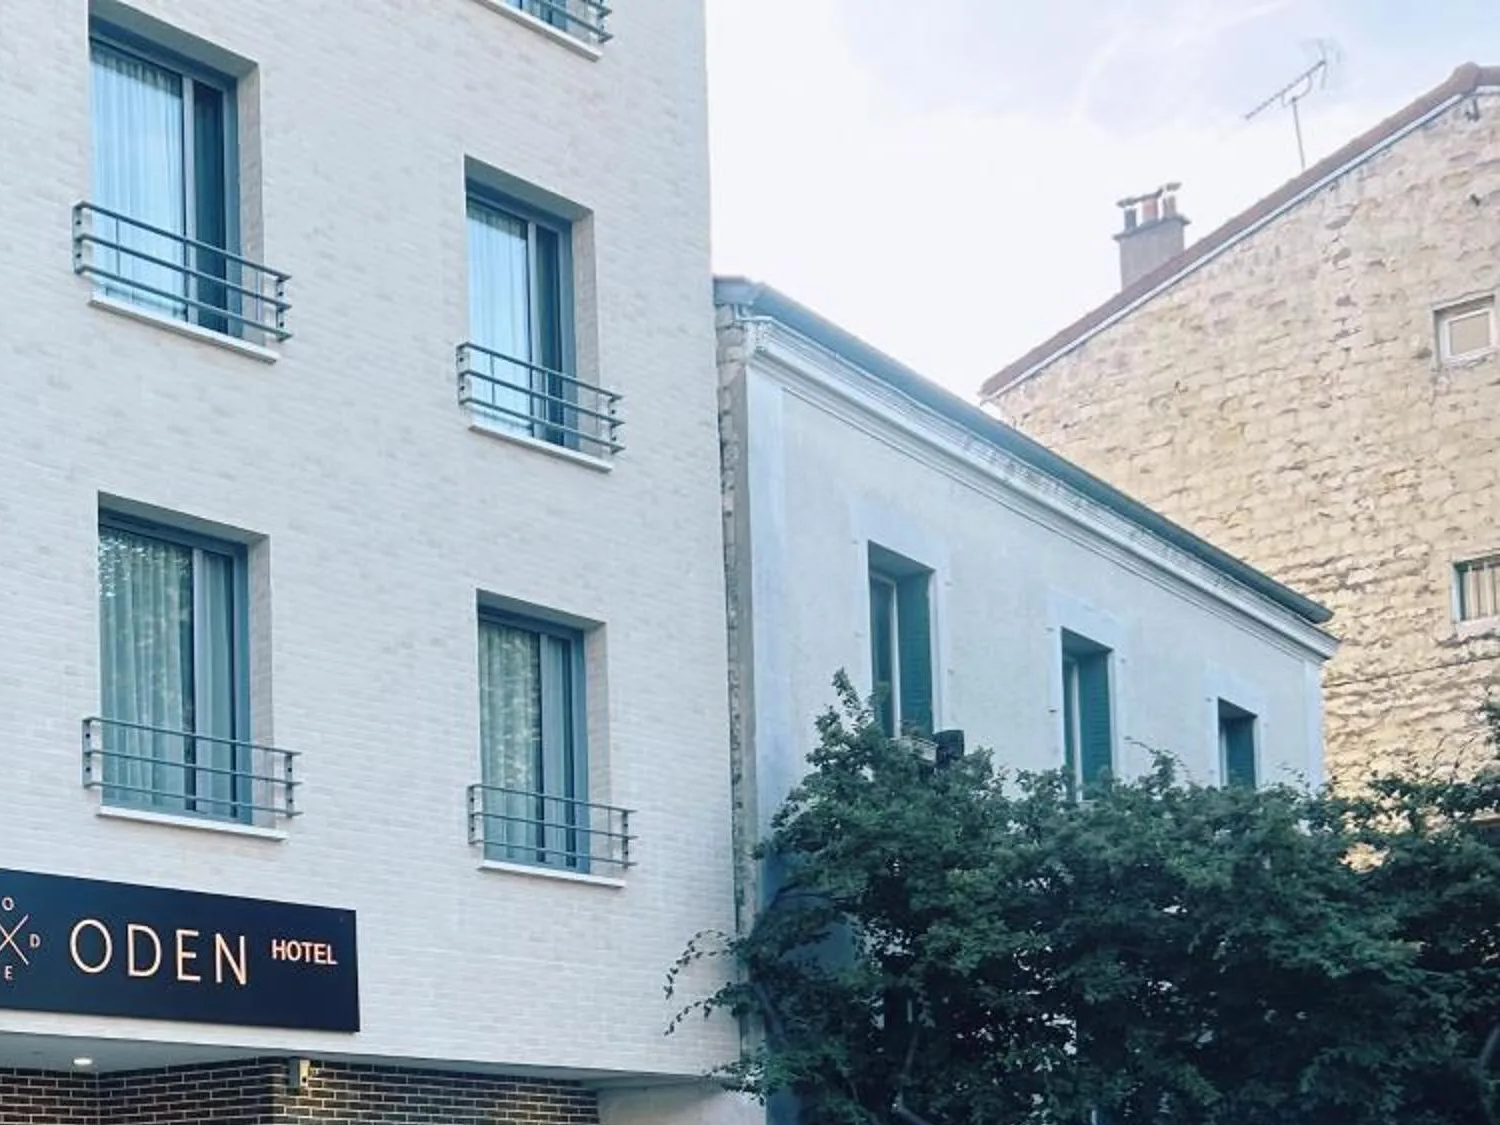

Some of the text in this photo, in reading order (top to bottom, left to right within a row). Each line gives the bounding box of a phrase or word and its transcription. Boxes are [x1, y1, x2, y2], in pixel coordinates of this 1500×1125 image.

[2, 897, 14, 911] O
[30, 933, 41, 948] D
[70, 919, 339, 986] ODEN HOTEL
[4, 965, 13, 981] E
